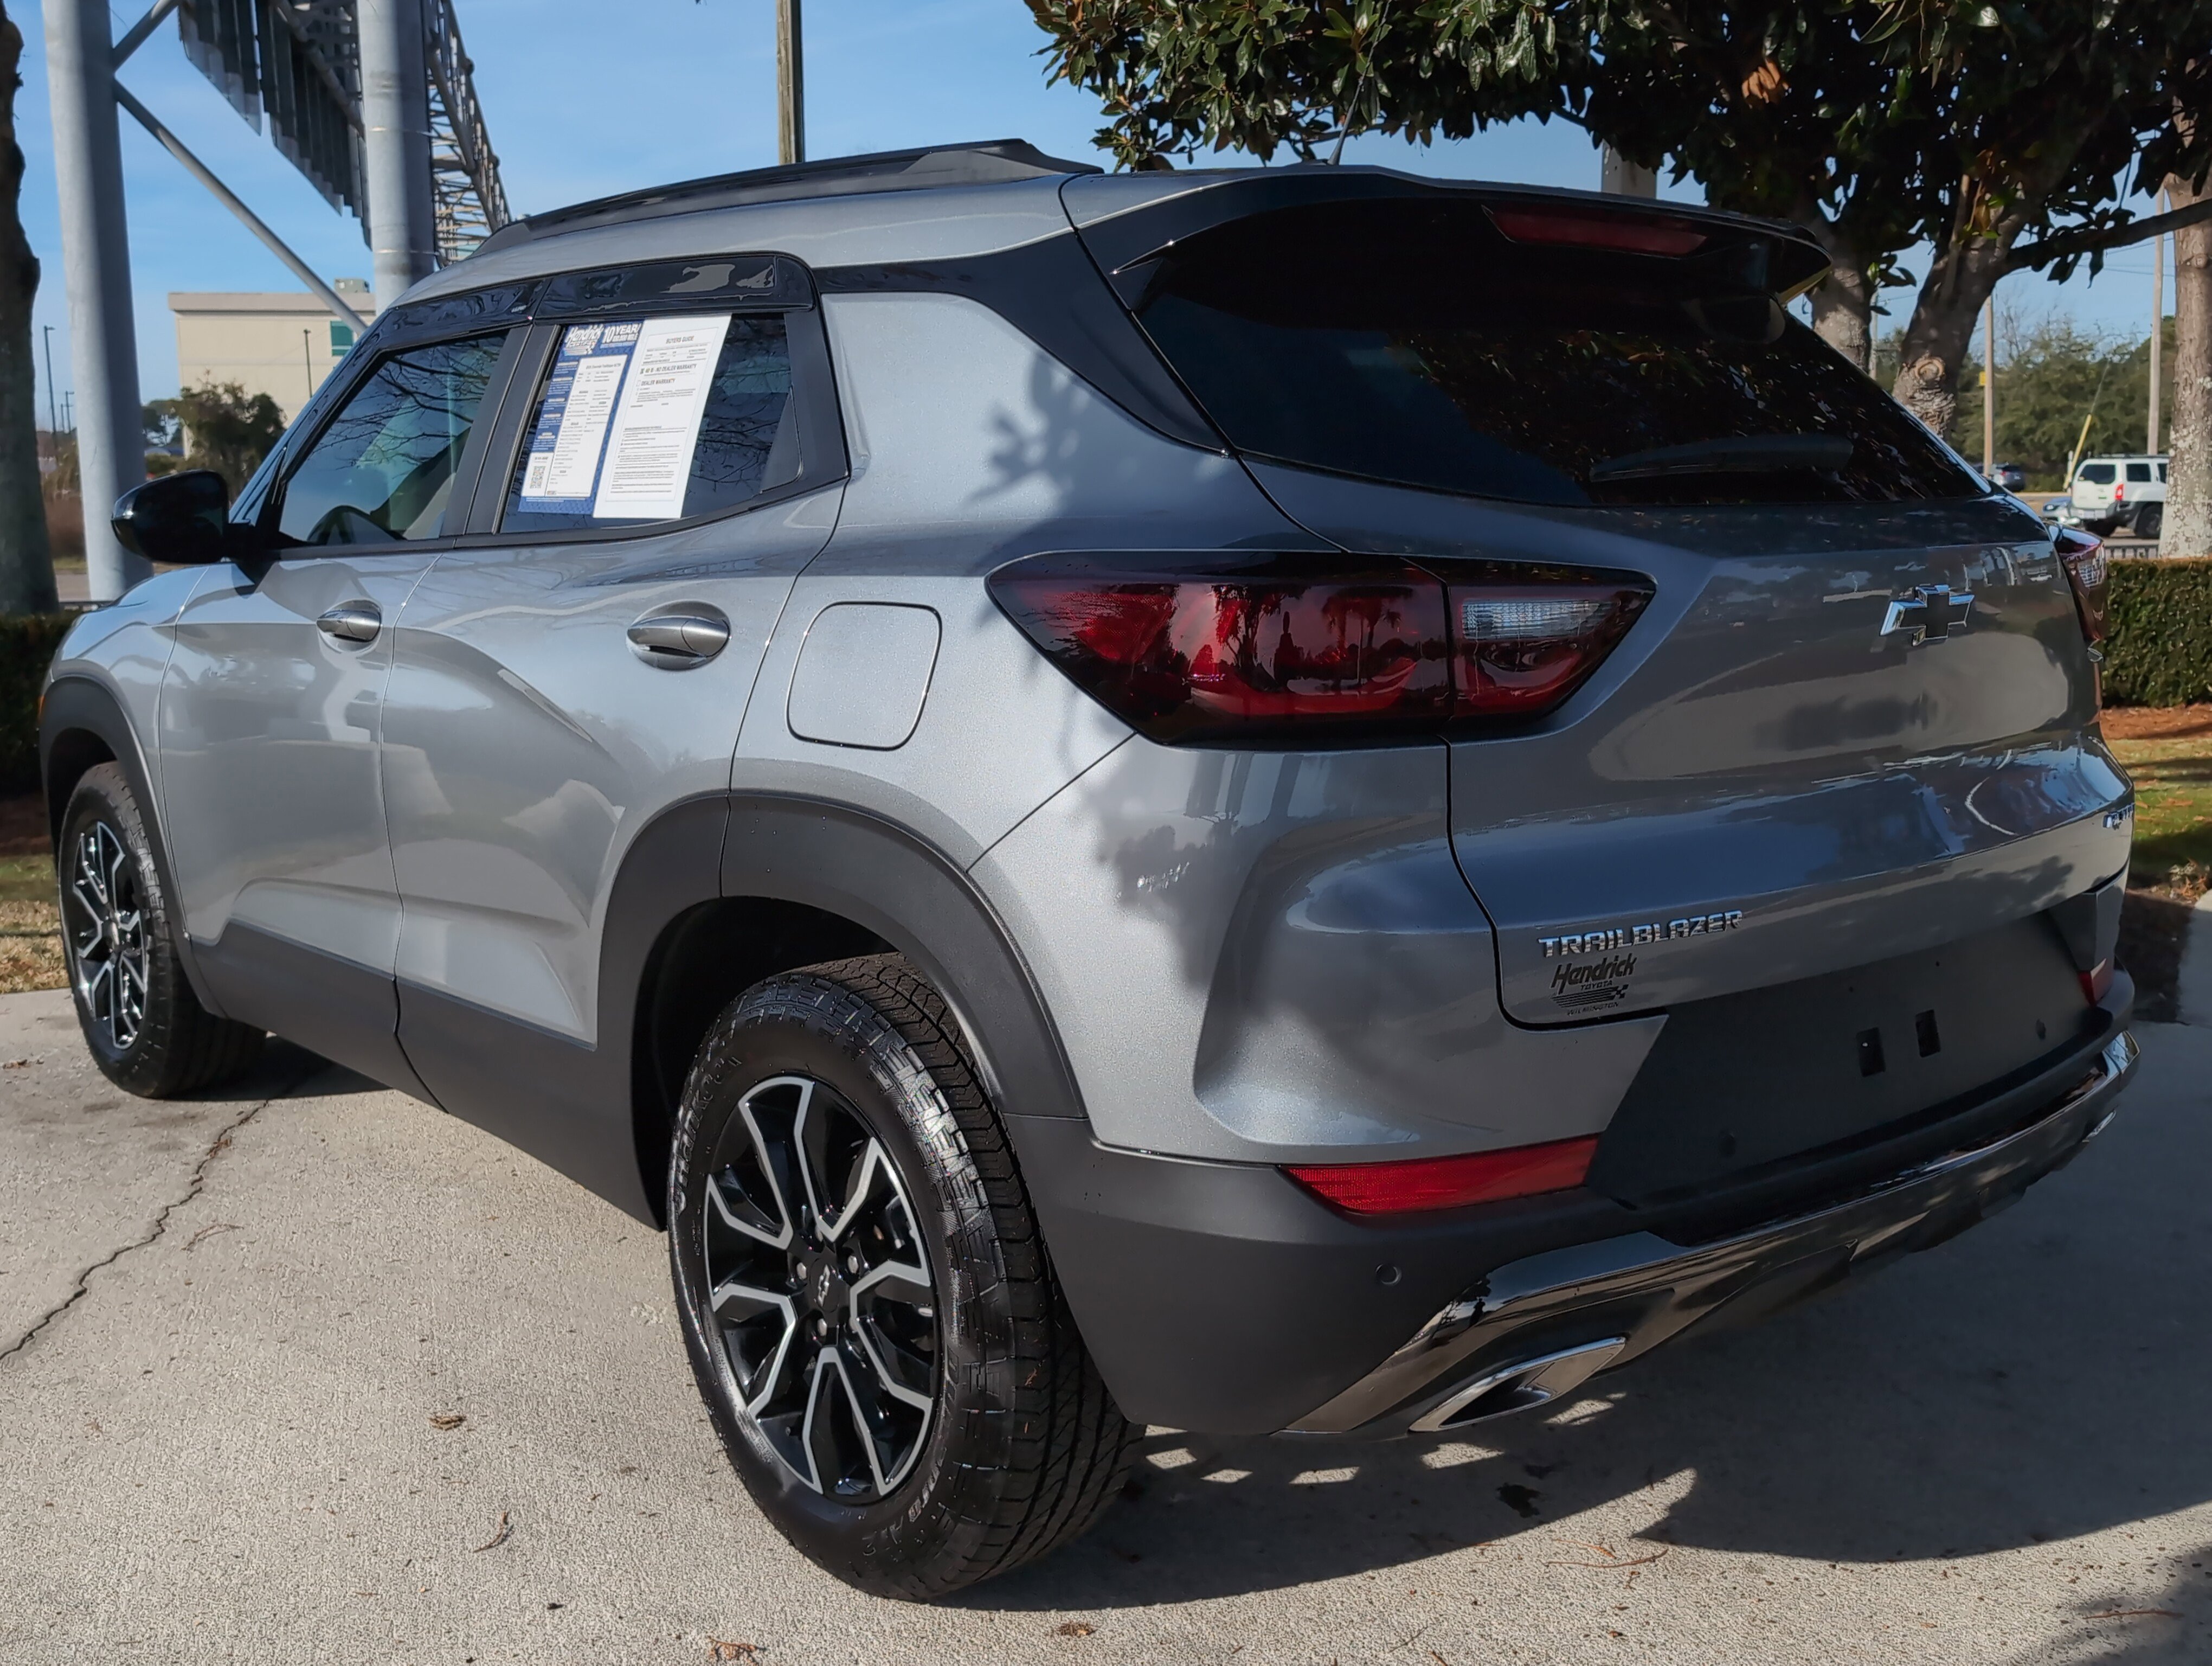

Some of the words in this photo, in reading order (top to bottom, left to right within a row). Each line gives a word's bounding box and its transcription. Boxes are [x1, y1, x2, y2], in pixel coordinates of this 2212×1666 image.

[602, 326, 616, 343] 10
[1538, 909, 1742, 958] TRAILBLAZER
[1550, 952, 1637, 995] Hendrick
[1580, 980, 1613, 991] TOYOTA
